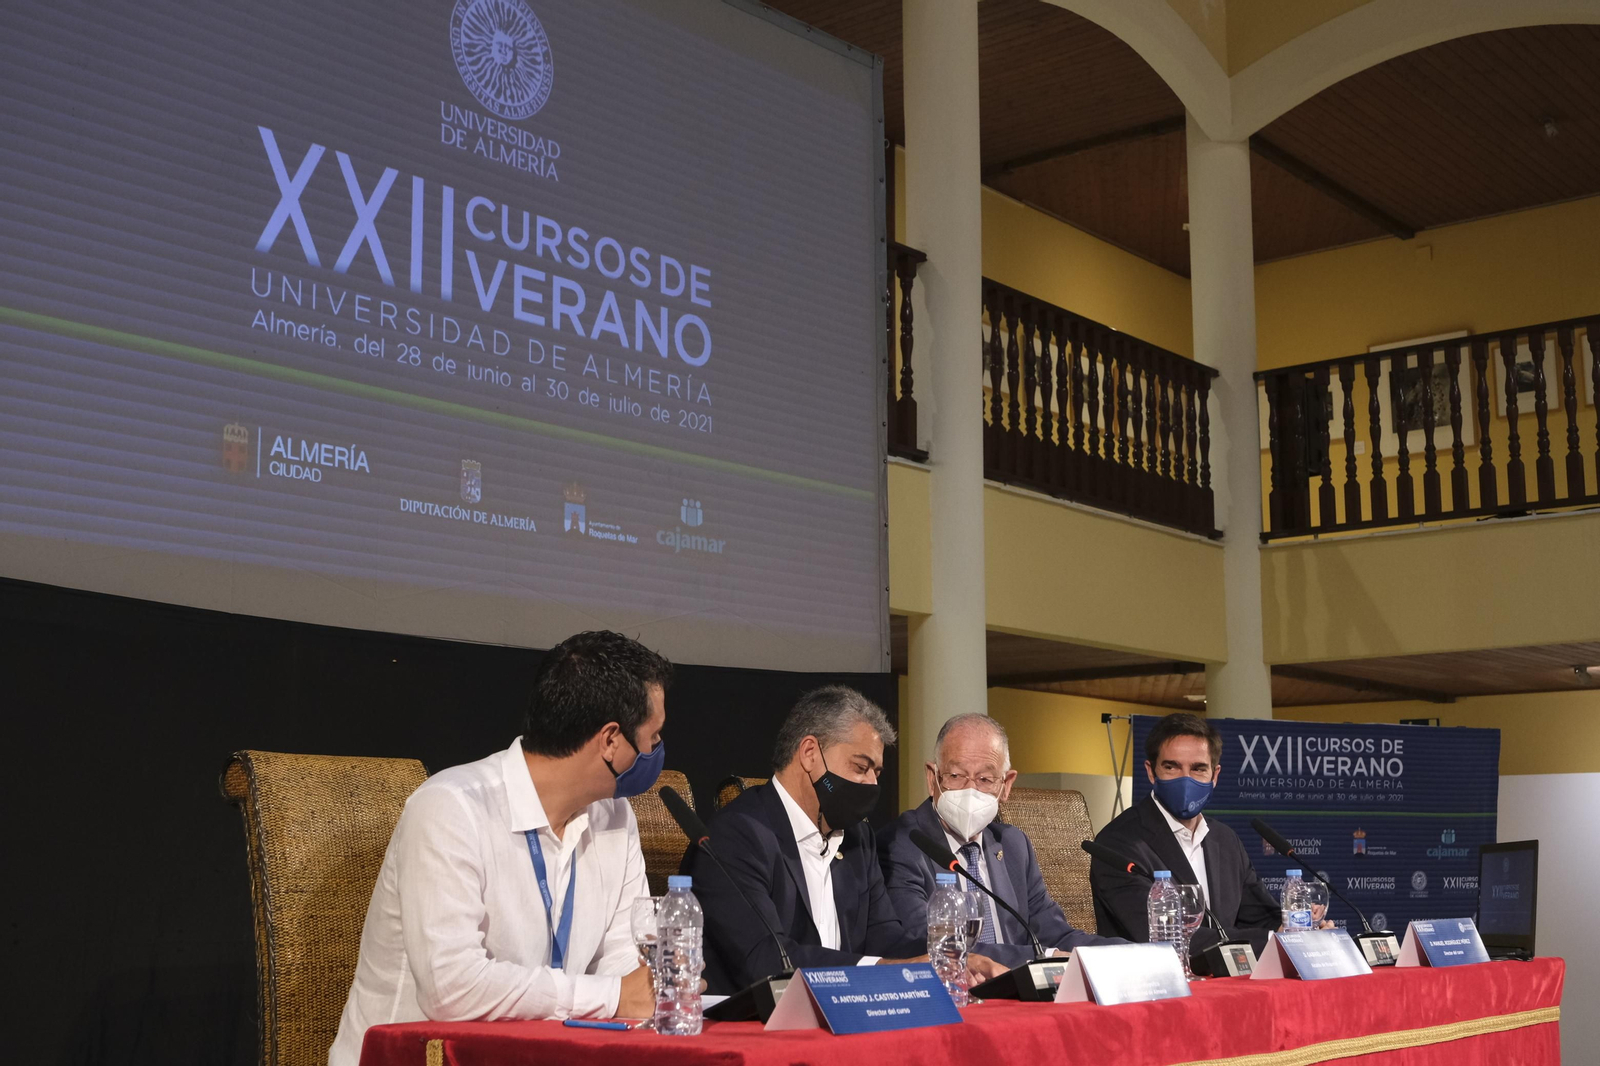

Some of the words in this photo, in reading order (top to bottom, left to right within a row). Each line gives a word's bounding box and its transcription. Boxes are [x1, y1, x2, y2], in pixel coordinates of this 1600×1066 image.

[441, 100, 561, 159] UNIVERSIDAD
[441, 122, 467, 150] DE
[473, 136, 559, 181] ALMERÍA
[254, 125, 454, 302] XXII
[465, 196, 652, 288] CURSOS
[660, 255, 712, 308] DE
[465, 250, 712, 367] VERANO
[251, 267, 511, 356] UNIVERSIDAD
[528, 338, 566, 372] DE
[582, 353, 712, 406] ALMERÍA
[354, 333, 385, 358] del
[397, 343, 421, 367] 28
[432, 352, 457, 375] de
[467, 359, 512, 387] junio
[521, 374, 536, 392] al
[546, 377, 569, 400] 30
[578, 387, 600, 408] de
[608, 393, 642, 417] julio
[650, 403, 670, 423] de
[678, 409, 712, 433] 2021
[269, 435, 370, 473] ALMERÍA
[269, 460, 322, 483] CIUDAD
[400, 498, 470, 521] DIPUTACIÓN
[473, 510, 488, 524] DE
[490, 514, 537, 532] ALMERÍA
[588, 528, 617, 541] Roquetas
[617, 533, 626, 542] de
[626, 534, 639, 544] Mar
[656, 526, 727, 554] cajamar
[1238, 734, 1303, 776] XXII
[1305, 737, 1375, 753] CURSOS
[1381, 739, 1404, 755] DE
[1305, 756, 1404, 778] VERANO
[1237, 777, 1325, 789] UNIVERSIDAD
[1329, 778, 1345, 789] DE
[1350, 778, 1404, 790] ALMERÍA
[1269, 791, 1281, 800] del
[1284, 792, 1293, 800] 28
[1295, 792, 1305, 800] de
[1307, 793, 1325, 801] junio
[1336, 793, 1346, 801] 30
[1348, 793, 1358, 801] de
[1388, 794, 1404, 802] 2021
[1286, 837, 1322, 847] UTACIÓN
[1293, 846, 1320, 855] LMERÍA
[1426, 845, 1470, 860] cajamar
[1346, 877, 1367, 890] XXII
[1366, 882, 1396, 890] VERANO
[1443, 876, 1462, 889] XXII
[805, 971, 824, 984] XXII
[823, 976, 849, 984] VERANO
[831, 996, 840, 1004] D.
[840, 994, 868, 1004] ANTONIO
[868, 994, 875, 1002] J.
[875, 993, 899, 1002] CASTRO
[899, 990, 931, 1001] MARTÍNEZ
[866, 1008, 887, 1017] Director
[887, 1007, 896, 1016] del
[896, 1007, 911, 1015] curso
